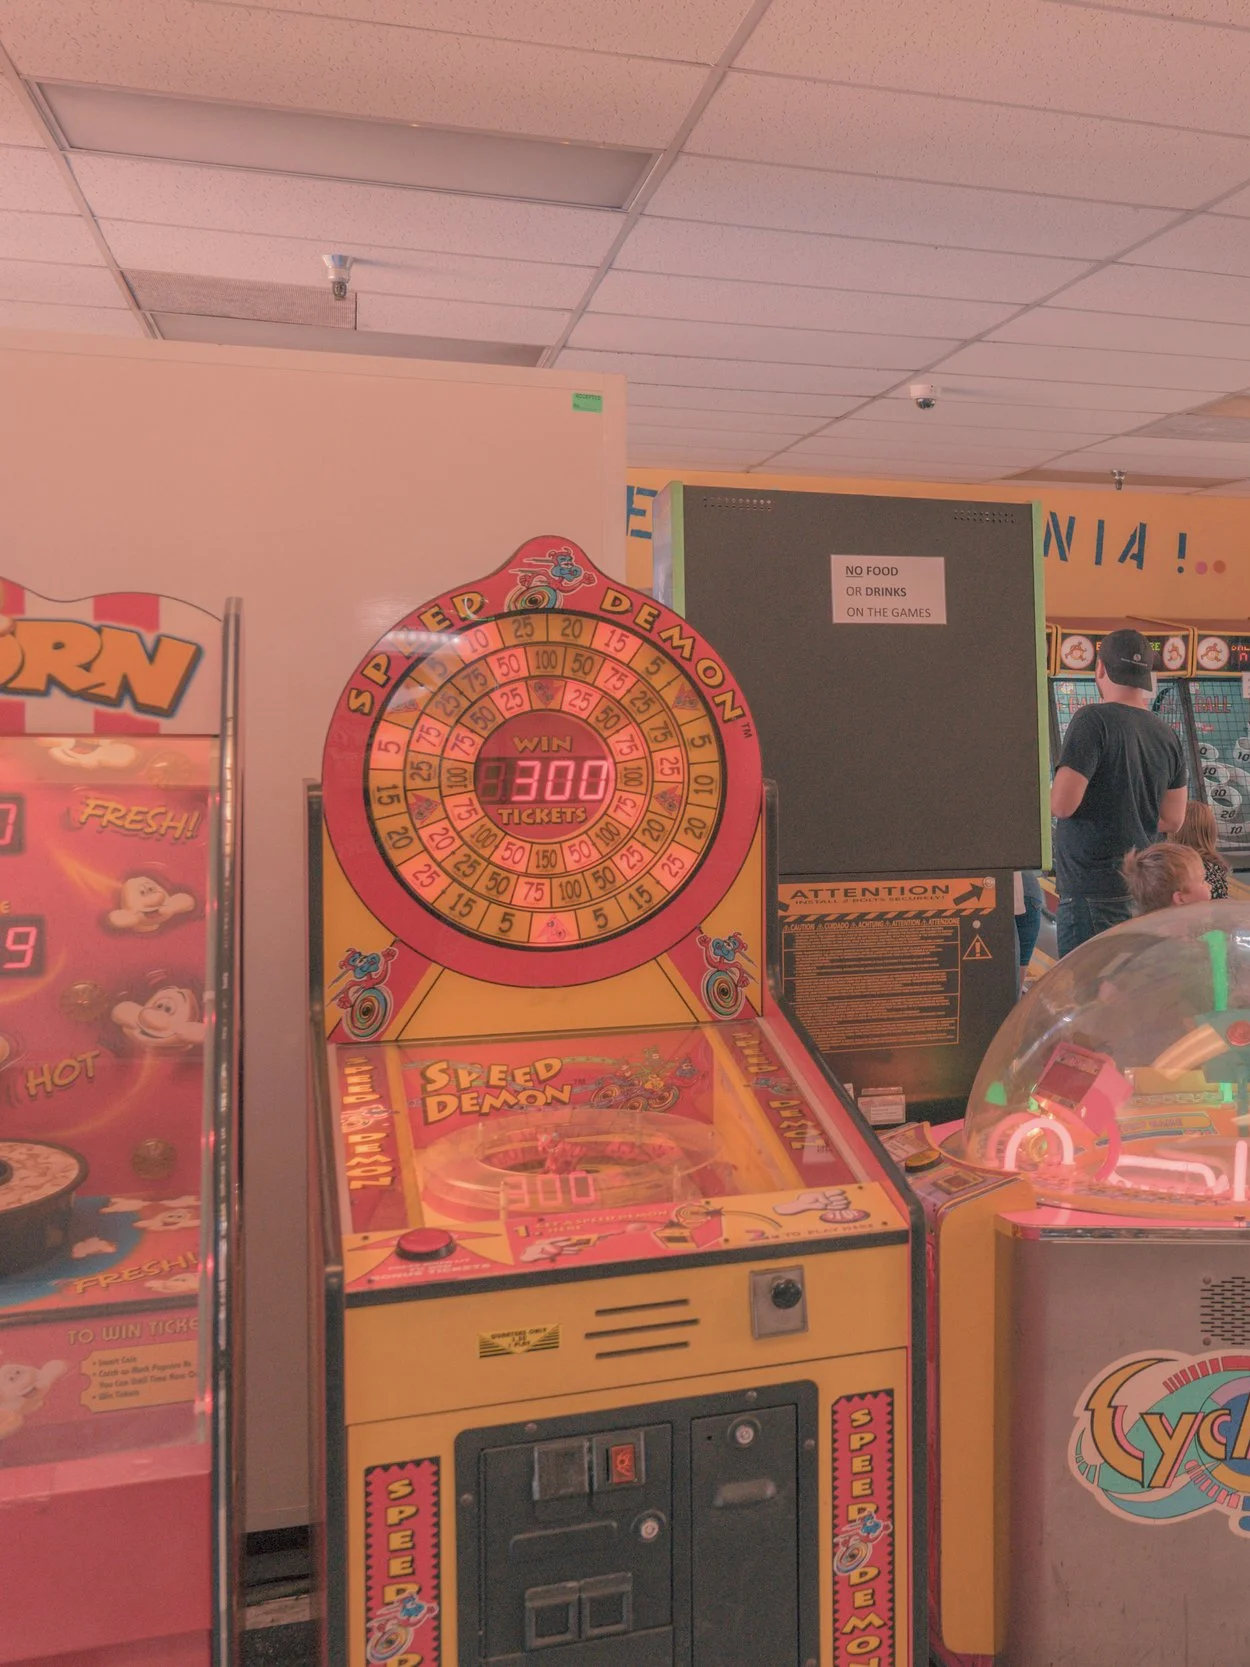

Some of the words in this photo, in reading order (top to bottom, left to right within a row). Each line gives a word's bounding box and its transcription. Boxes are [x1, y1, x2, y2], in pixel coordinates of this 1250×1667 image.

[845, 565, 863, 577] NO
[867, 566, 898, 576] FOOD
[846, 587, 862, 596] OR
[866, 587, 907, 597] DRINKS
[847, 607, 864, 617] ON
[867, 607, 888, 617] THE
[892, 608, 931, 617] GAMES
[512, 617, 535, 638] 25
[560, 618, 583, 639] 20
[467, 629, 488, 652] 10
[603, 628, 629, 653] 15
[497, 653, 520, 677] 50
[535, 648, 558, 669] 100
[571, 652, 594, 675] 50
[600, 587, 746, 723] DEMON
[645, 656, 666, 677] 5
[461, 668, 487, 693] 75
[606, 666, 629, 691] 75
[499, 687, 523, 711] 25
[568, 689, 593, 712] 25
[629, 690, 653, 715] 25
[470, 705, 497, 730] 50
[596, 705, 621, 730] 50
[416, 724, 441, 748] 75
[451, 732, 476, 756] 75
[649, 720, 674, 744] 75
[690, 734, 712, 749] 5
[378, 739, 401, 755] 5
[512, 735, 573, 754] WIN
[616, 734, 639, 756] 75
[410, 760, 432, 782] 25
[446, 766, 468, 789] 100
[623, 766, 643, 787] 100
[659, 756, 680, 776] 25
[510, 760, 609, 802] 300
[694, 774, 714, 795] 10
[376, 784, 400, 806] 15
[613, 795, 637, 817] 75
[78, 798, 201, 840] FRESH!
[452, 797, 478, 821] 75
[497, 807, 587, 826] TICKETS
[387, 826, 413, 850] 20
[428, 827, 455, 850] 20
[470, 823, 498, 849] 100
[595, 822, 620, 847] 100
[643, 818, 665, 841] 20
[684, 816, 707, 840] 20
[1230, 826, 1243, 835] 10
[501, 841, 525, 865] 50
[536, 849, 557, 869] 150
[568, 840, 592, 864] 50
[620, 845, 644, 870] 25
[412, 863, 440, 888] 25
[453, 853, 481, 878] 25
[661, 853, 685, 878] 25
[485, 871, 510, 895] 50
[559, 879, 582, 900] 100
[592, 866, 616, 890] 50
[523, 881, 545, 902] 75
[628, 885, 652, 910] 15
[790, 885, 949, 899] ATTENTION
[449, 892, 477, 917] 15
[498, 912, 516, 932] 5
[592, 907, 608, 929] 5
[24, 1050, 100, 1096] HOT
[420, 1057, 563, 1092] SPEED
[423, 1085, 572, 1125] DEMON
[345, 1132, 396, 1190] DEMON
[73, 1251, 199, 1293] FRESH!
[68, 1328, 94, 1345] TO
[102, 1323, 142, 1341] WIN
[846, 1408, 879, 1522] SPEED
[383, 1479, 422, 1604] SPEED
